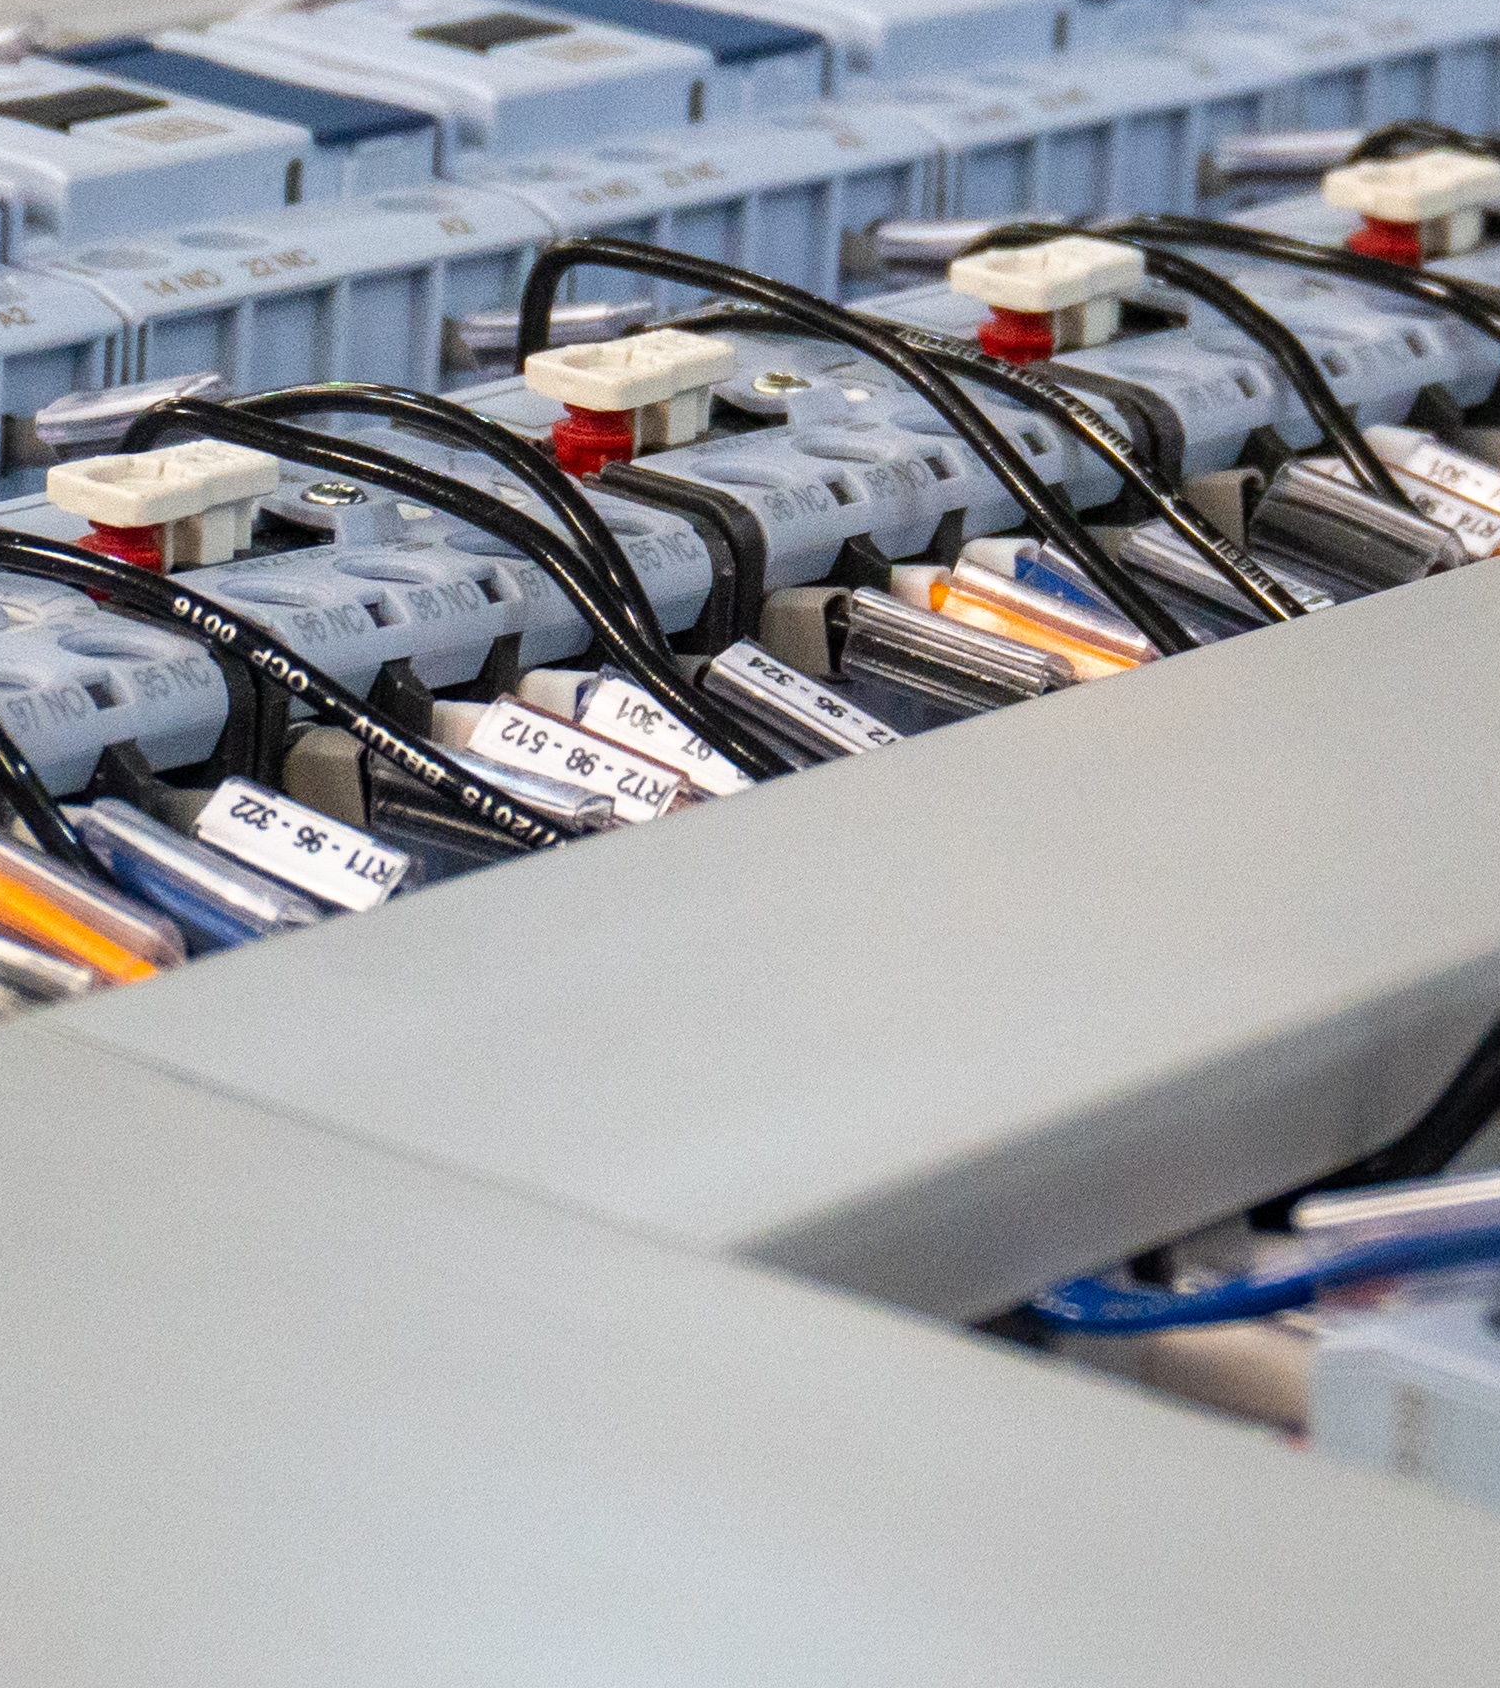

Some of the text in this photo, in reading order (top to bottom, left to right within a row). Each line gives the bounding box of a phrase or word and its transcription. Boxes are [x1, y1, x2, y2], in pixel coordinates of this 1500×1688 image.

[1456, 512, 1500, 540] RT4
[656, 530, 700, 562] NC
[440, 579, 480, 611] NO
[172, 595, 239, 645] 0016
[325, 602, 367, 635] NC
[163, 655, 212, 691] NC
[250, 648, 310, 694] OCP
[39, 683, 88, 723] NO
[615, 694, 664, 736] 301
[498, 715, 550, 756] 512
[565, 748, 602, 777] 98
[616, 769, 671, 809] RT2
[229, 793, 279, 831] 322
[344, 849, 396, 885] RT1
